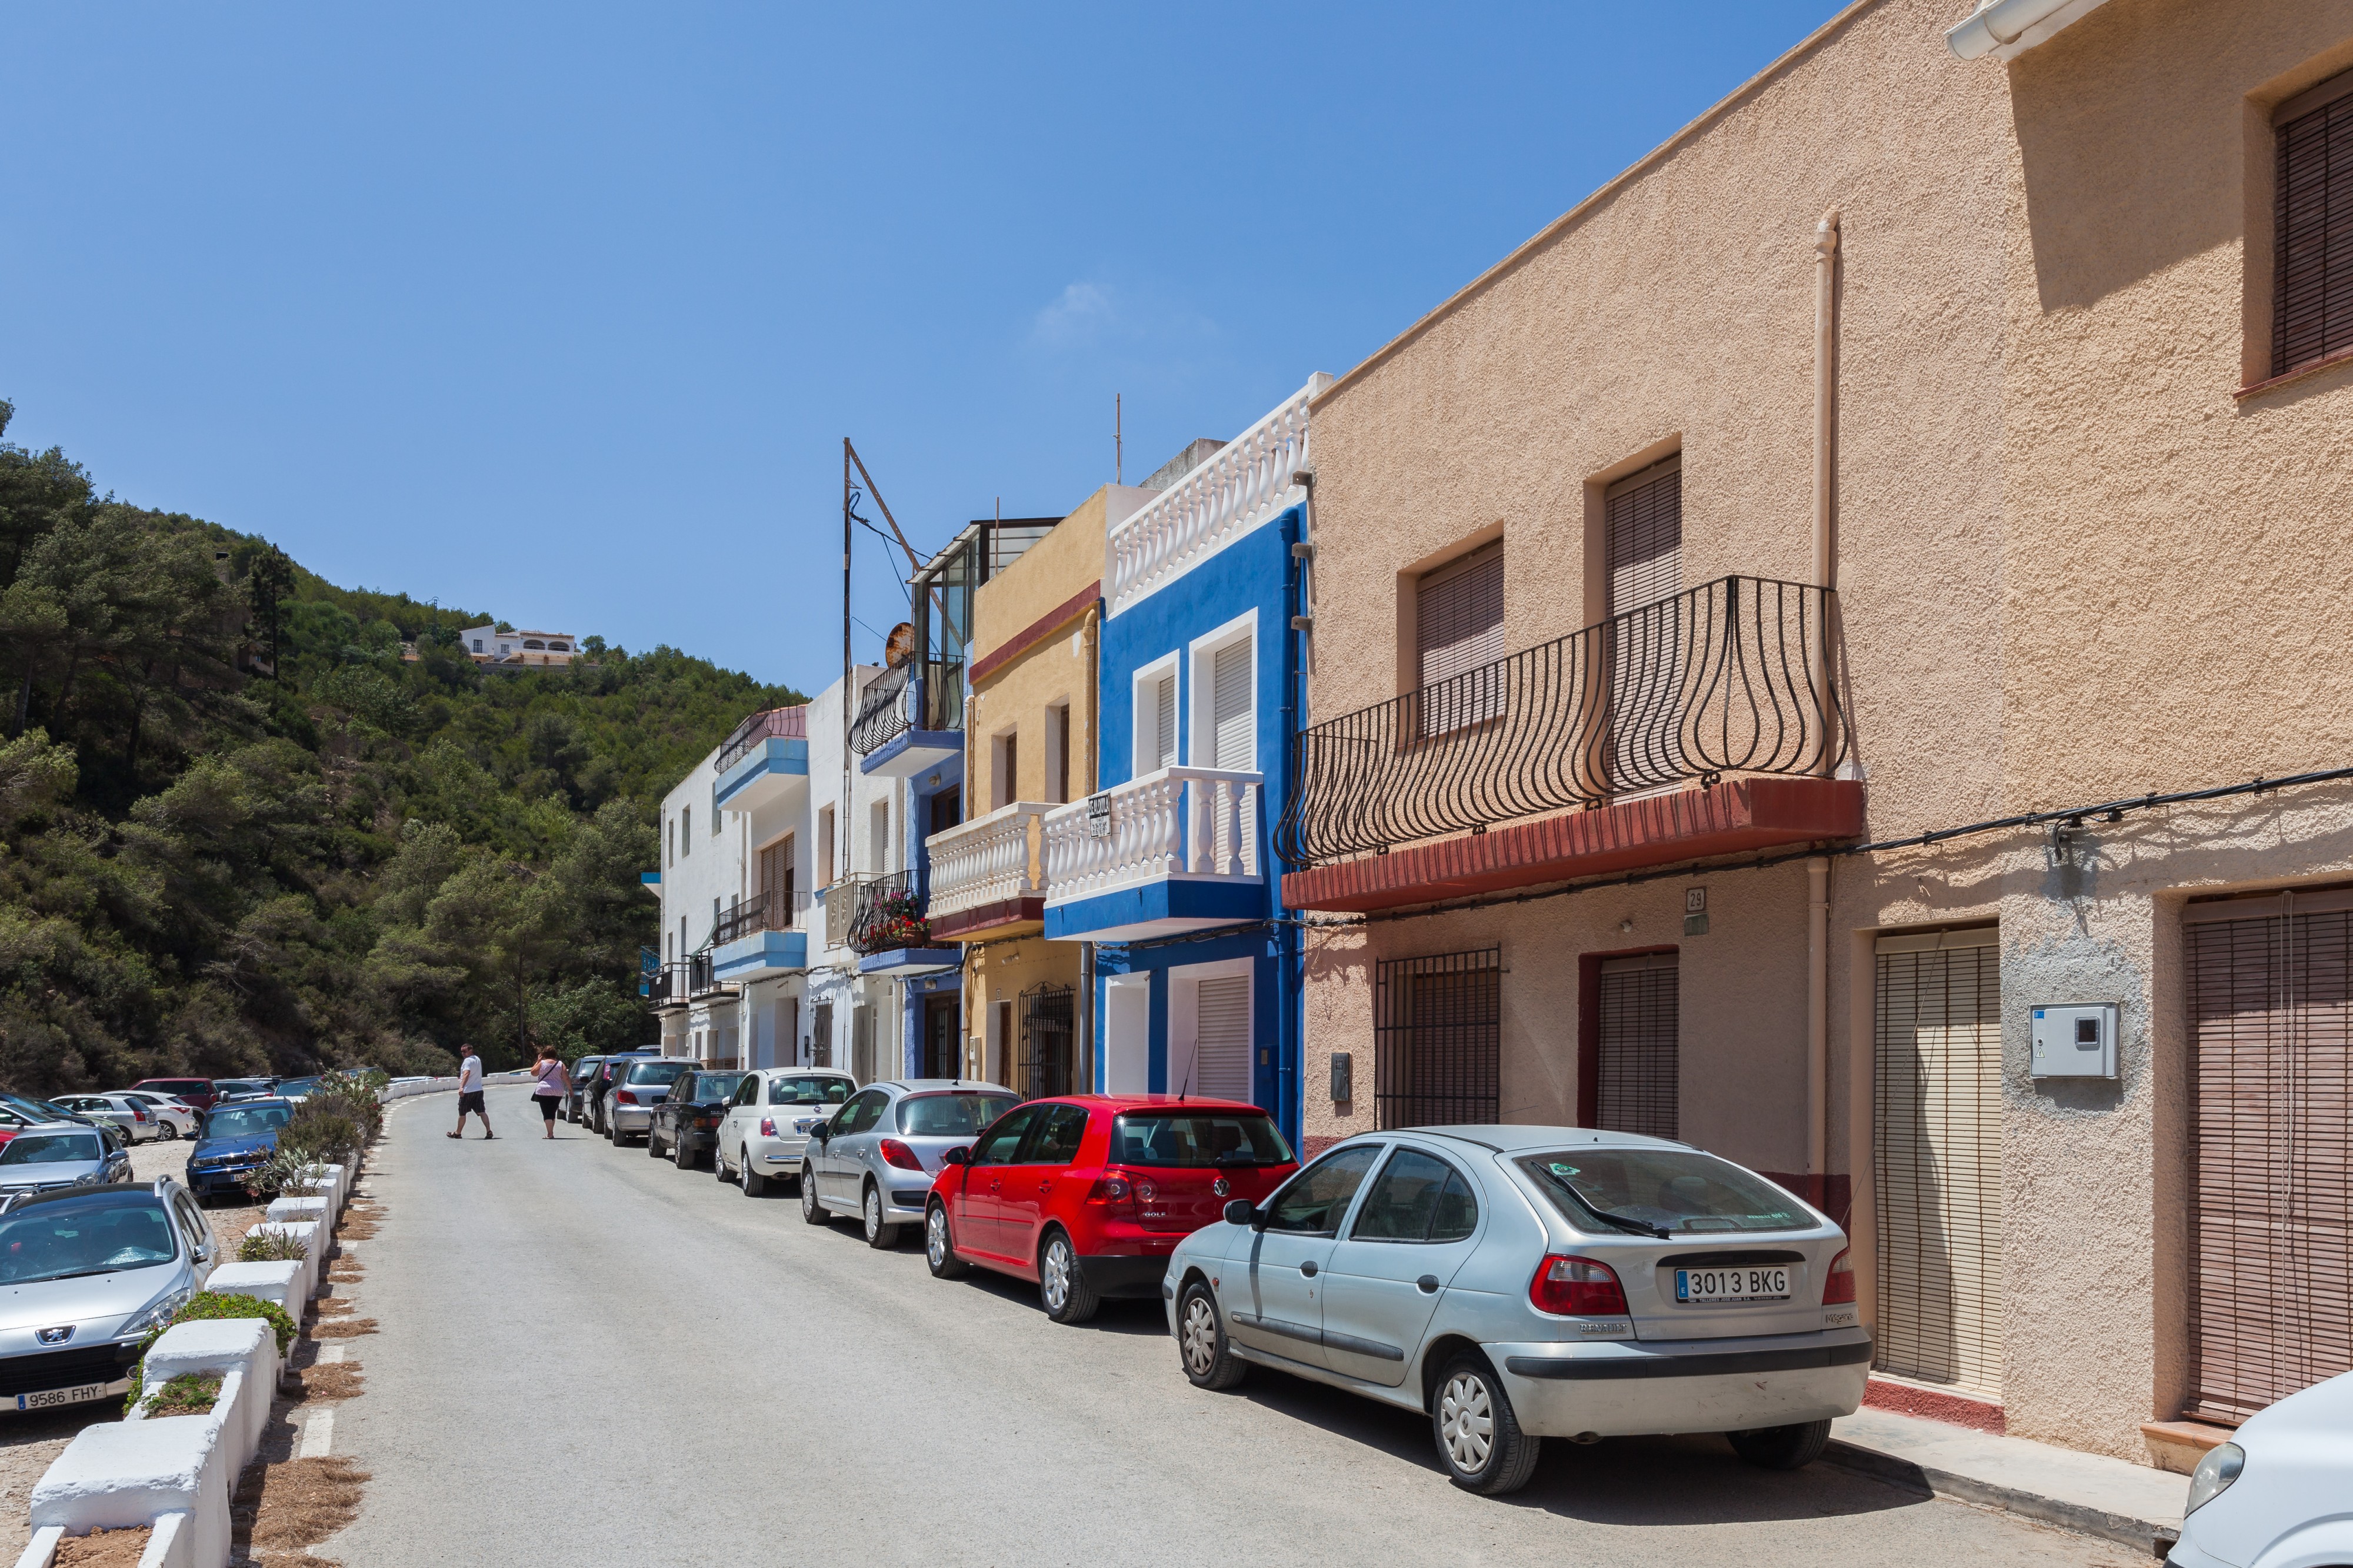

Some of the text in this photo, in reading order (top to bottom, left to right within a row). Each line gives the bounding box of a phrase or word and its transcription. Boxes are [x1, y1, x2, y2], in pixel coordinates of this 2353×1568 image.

[1089, 796, 1109, 816] SE ALQUILA
[1690, 892, 1702, 907] 29
[1691, 1270, 1786, 1295] 3013 BKG
[1579, 1323, 1628, 1333] RENAULT
[29, 1385, 98, 1407] 9586 FHY
